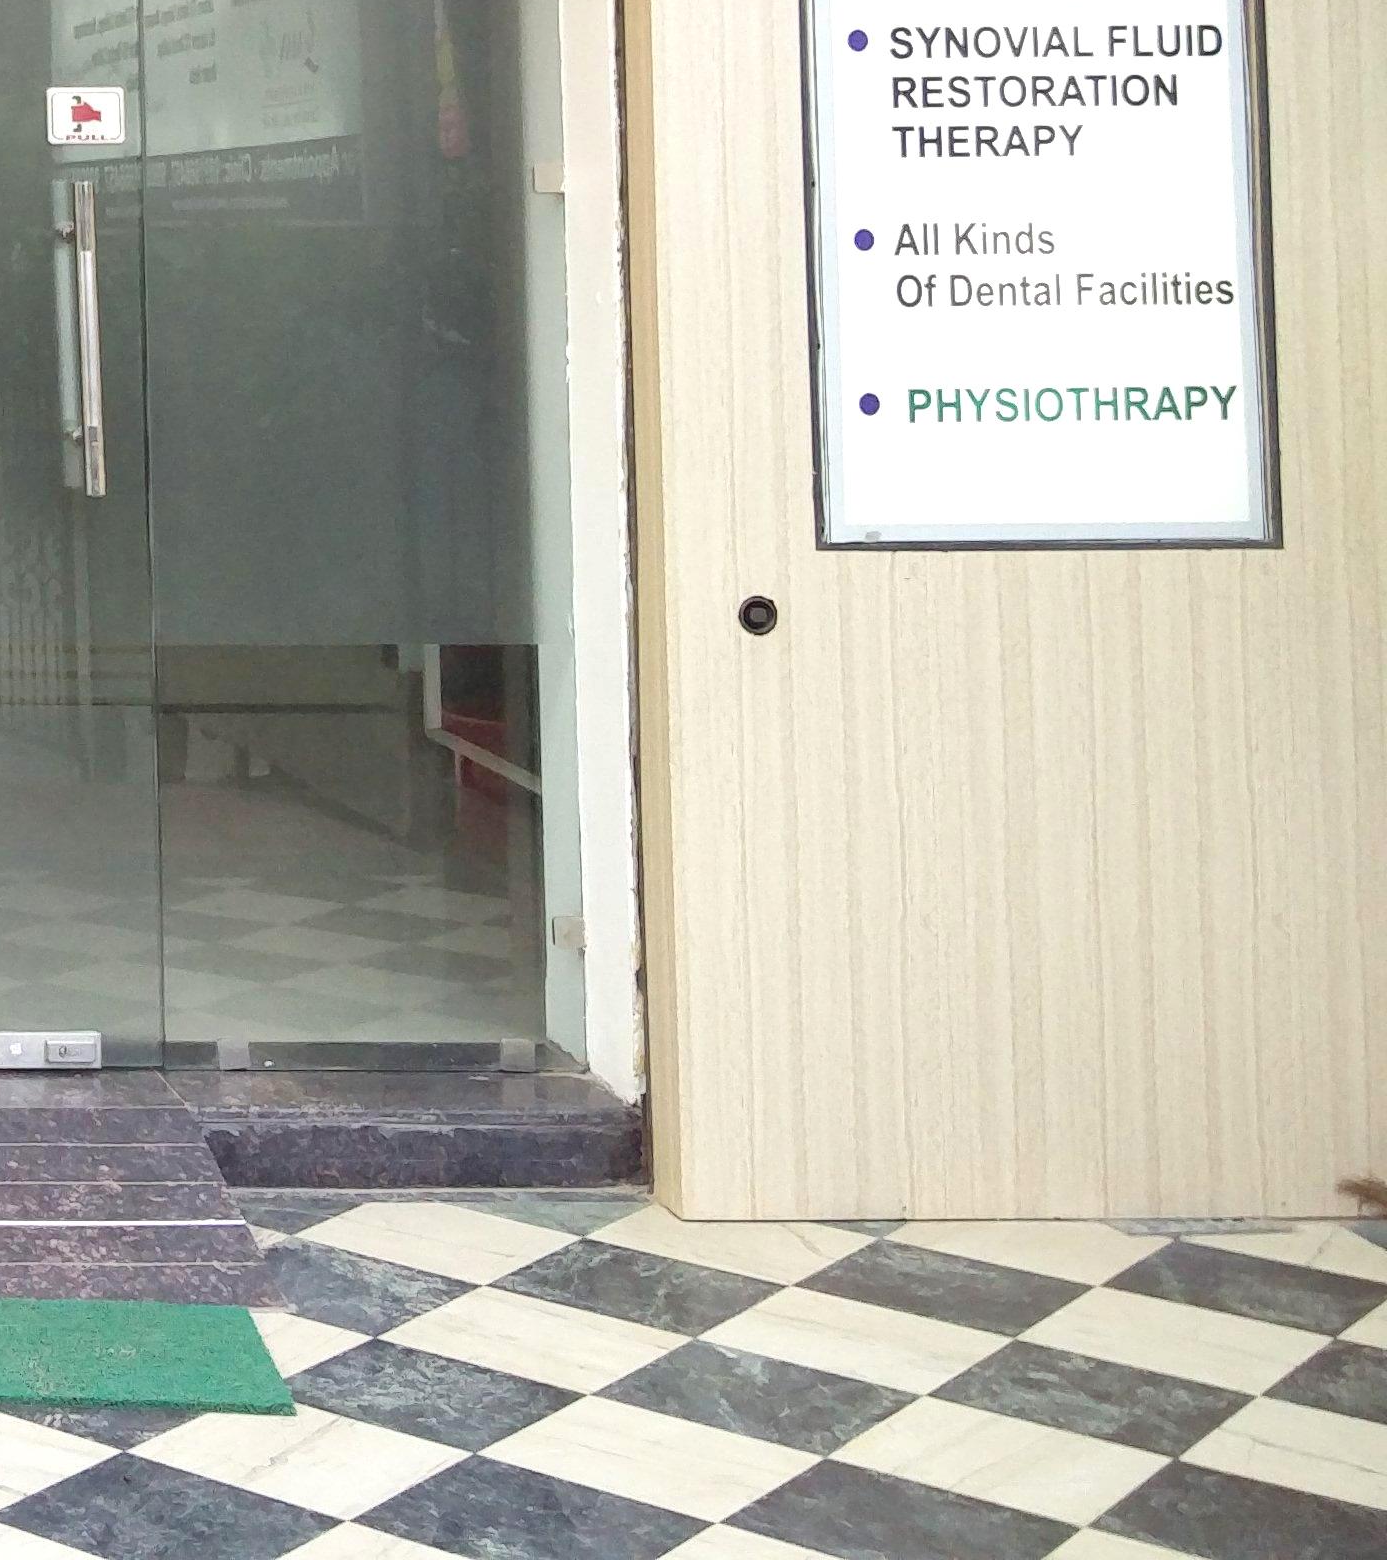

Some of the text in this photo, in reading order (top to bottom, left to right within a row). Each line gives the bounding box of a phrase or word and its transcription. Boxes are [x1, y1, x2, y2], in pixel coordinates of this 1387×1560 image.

[890, 25, 1223, 59] SYNOVIAL FLUID
[892, 75, 1179, 108] RESTORATION
[892, 125, 1084, 158] THERAPY
[894, 223, 1055, 256] All Kinds
[896, 272, 1235, 308] Of Dental Facilities
[907, 386, 1237, 423] PHYSIOTHRAPY
